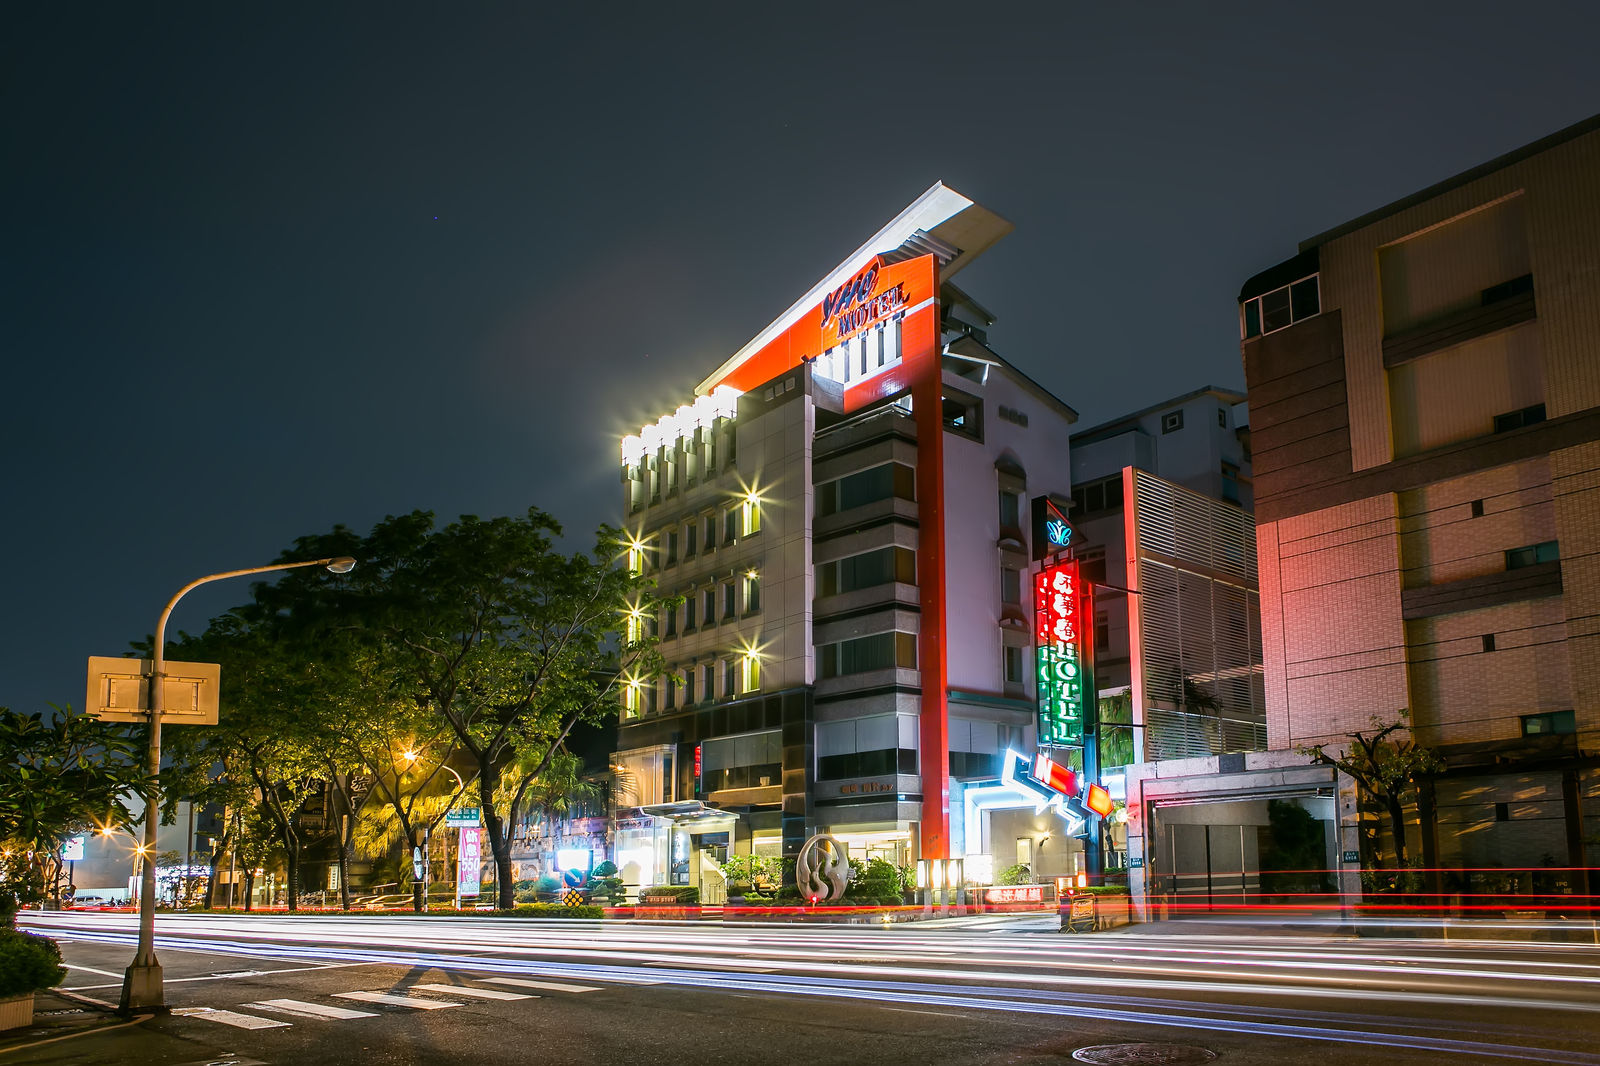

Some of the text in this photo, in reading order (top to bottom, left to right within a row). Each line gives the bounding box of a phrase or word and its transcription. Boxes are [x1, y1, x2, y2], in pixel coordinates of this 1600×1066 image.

[837, 281, 911, 339] MOTEL
[1056, 640, 1080, 741] HOTEL
[461, 858, 480, 872] 550
